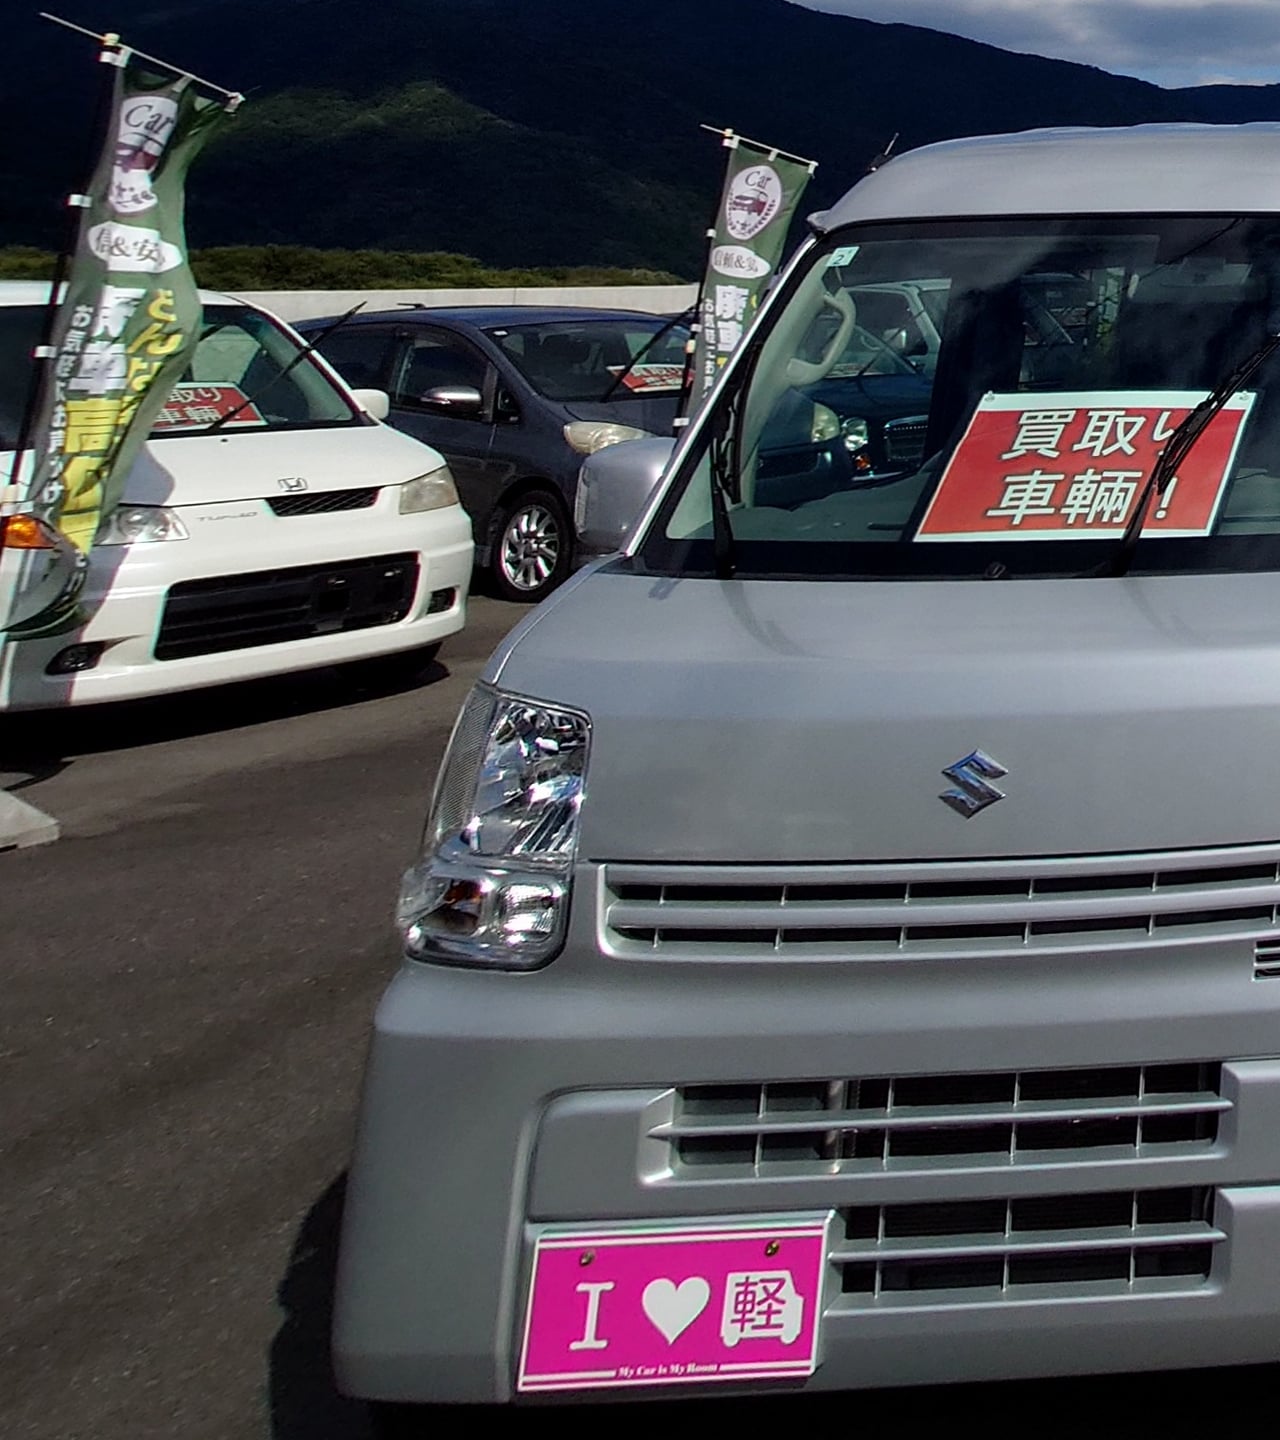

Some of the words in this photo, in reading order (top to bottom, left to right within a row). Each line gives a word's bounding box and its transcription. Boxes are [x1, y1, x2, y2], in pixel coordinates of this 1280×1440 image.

[124, 105, 174, 134] Car
[744, 171, 772, 189] Car
[569, 1281, 615, 1350] I
[730, 1276, 787, 1333] 軽
[618, 1366, 634, 1378] My
[669, 1362, 685, 1376] My
